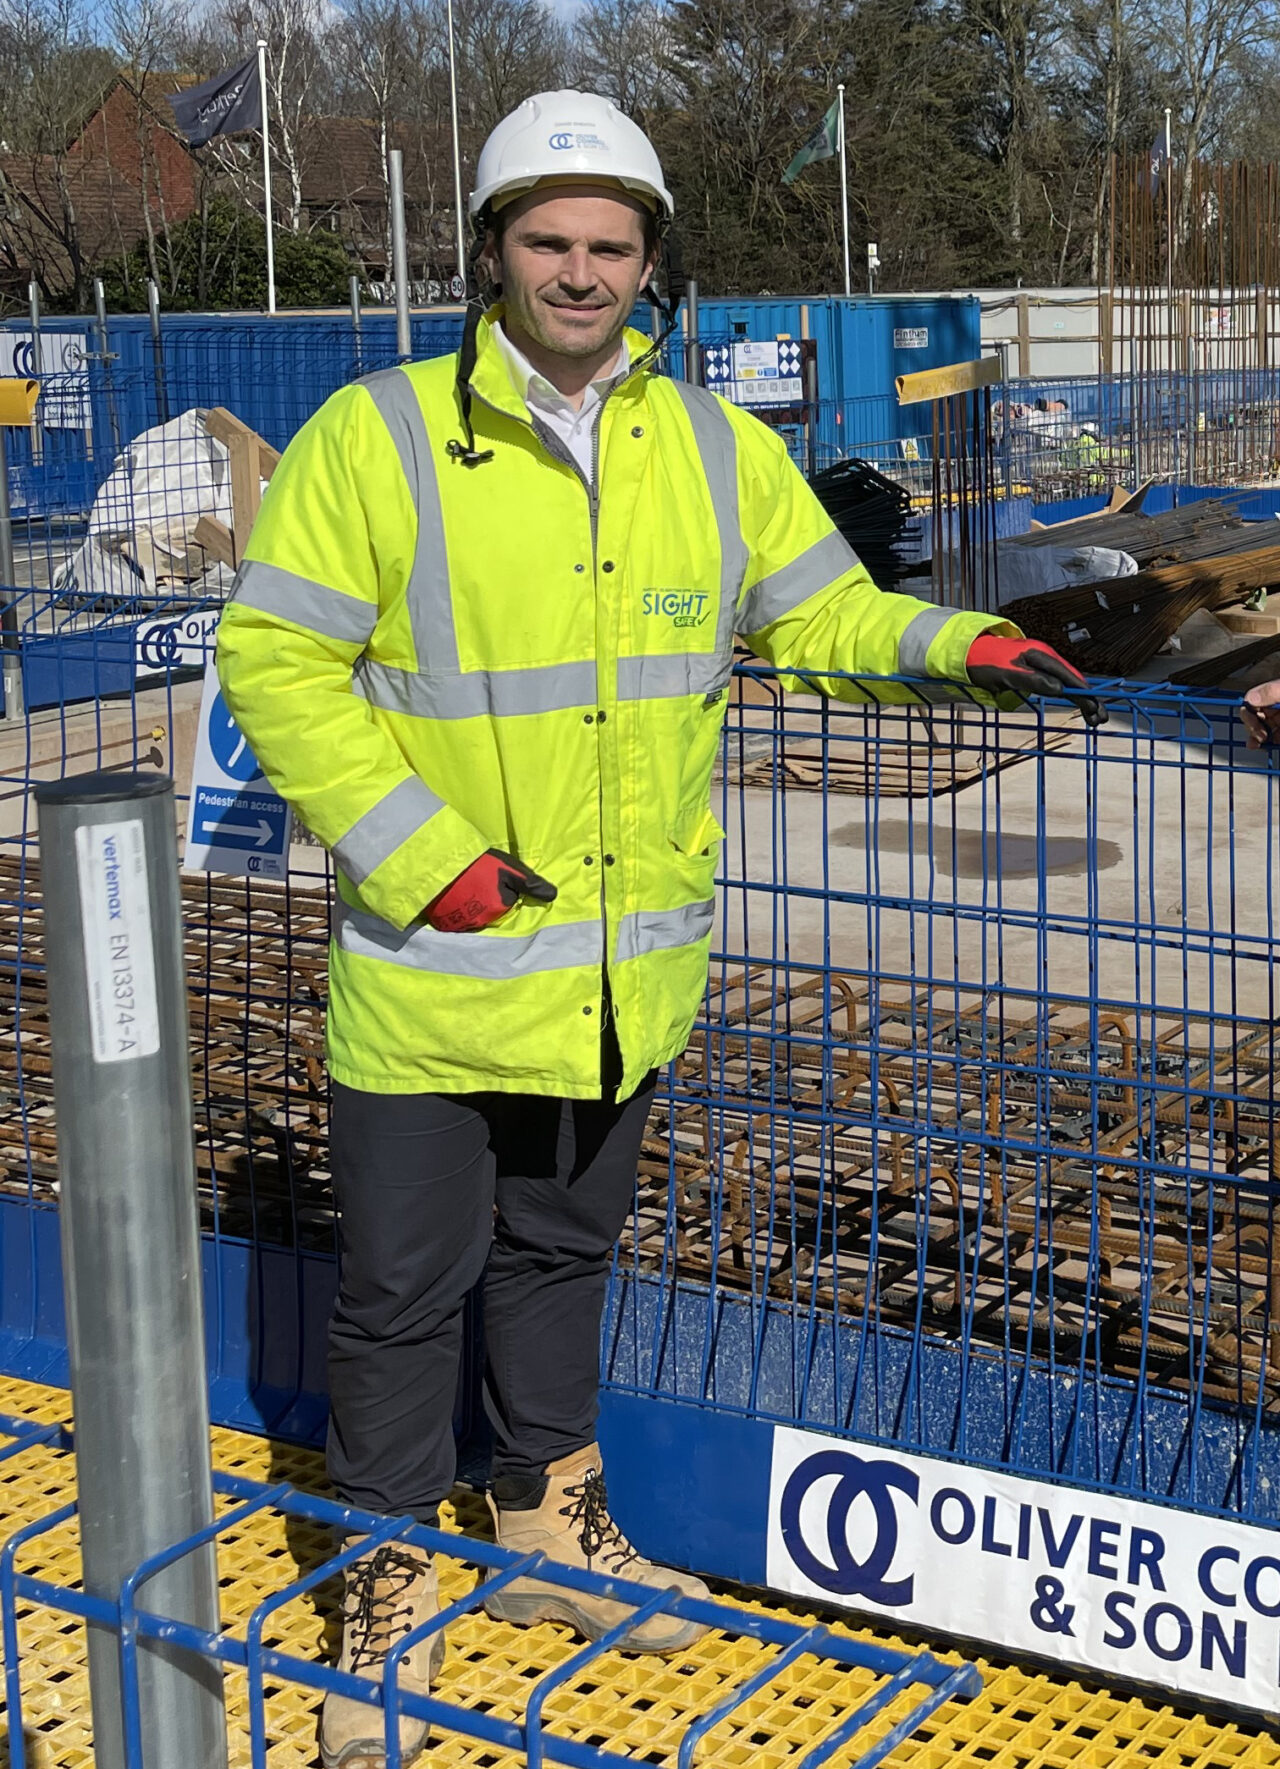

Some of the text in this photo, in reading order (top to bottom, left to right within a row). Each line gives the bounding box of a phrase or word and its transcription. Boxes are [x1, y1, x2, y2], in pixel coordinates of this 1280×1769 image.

[452, 281, 462, 291] 50
[642, 593, 709, 616] SIGHT
[674, 617, 694, 626] SAFE
[199, 792, 284, 813] Pedestrian access
[103, 834, 122, 920] vertemax
[110, 934, 130, 960] EN
[930, 1487, 1167, 1592] OLIVER
[1029, 1574, 1076, 1638] &
[1103, 1590, 1247, 1679] SON
